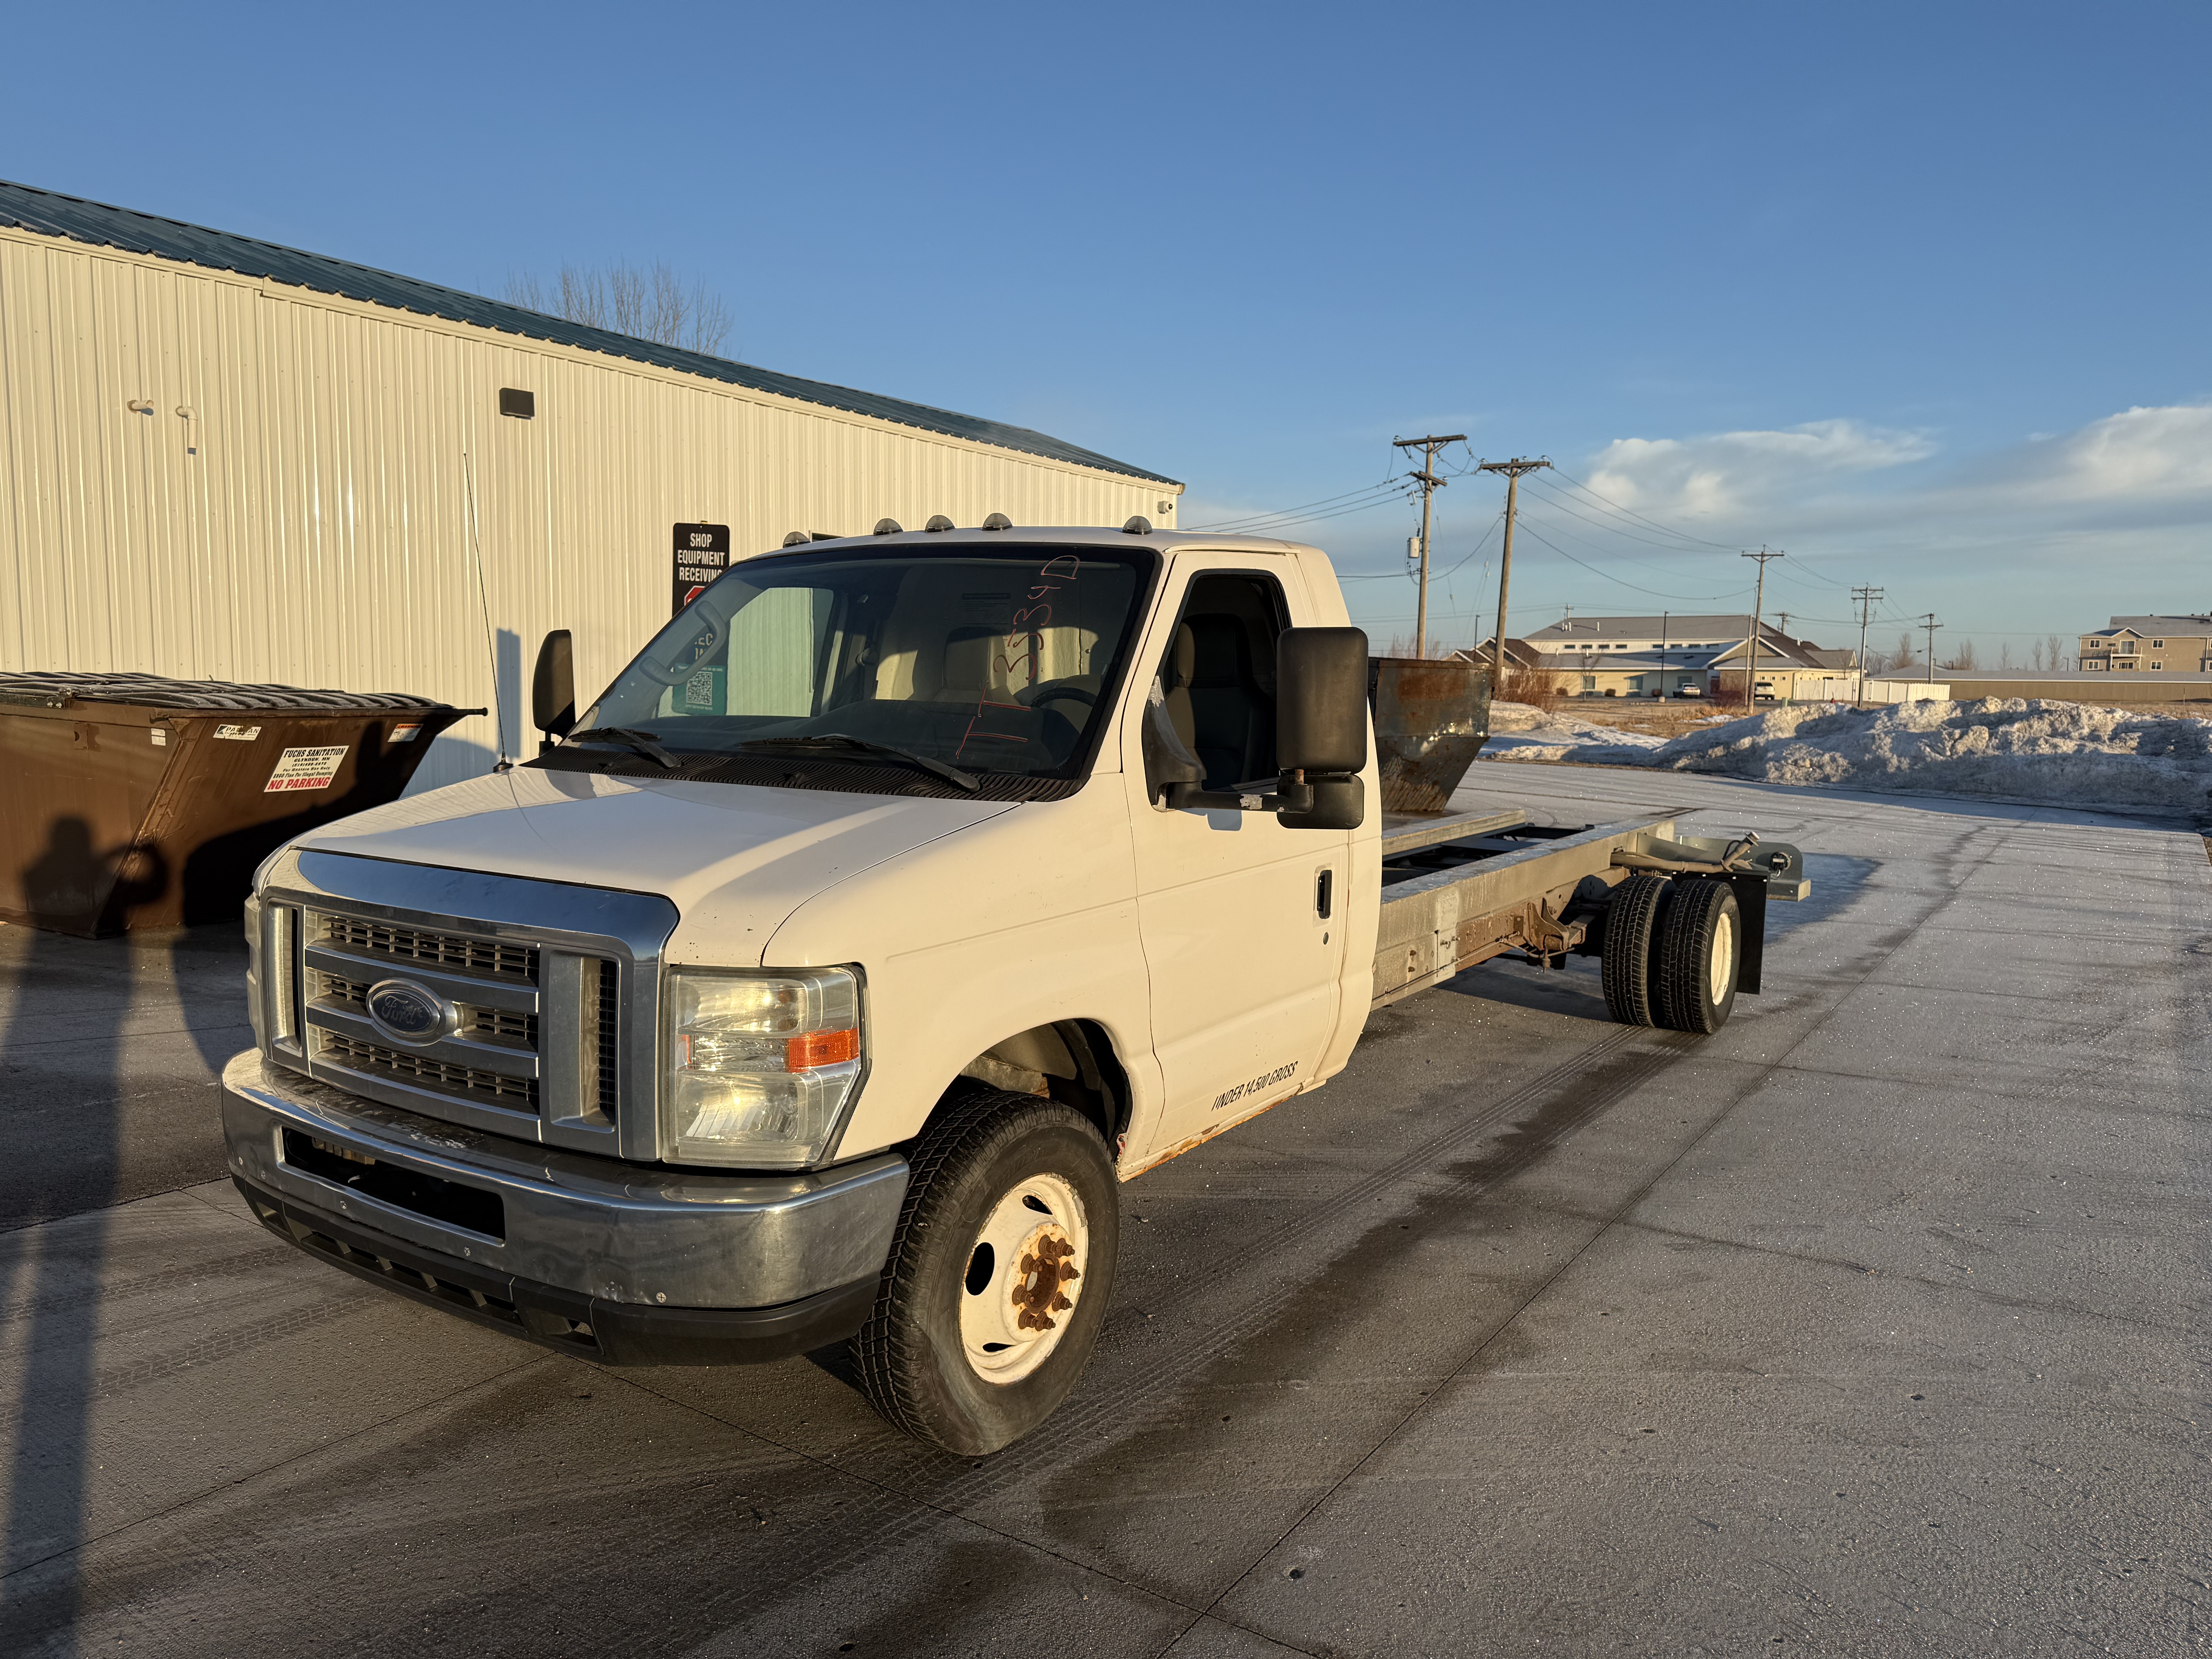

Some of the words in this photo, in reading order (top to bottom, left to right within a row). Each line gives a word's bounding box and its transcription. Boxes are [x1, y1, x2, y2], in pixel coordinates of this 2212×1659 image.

[690, 533, 712, 548] SHOP
[678, 550, 725, 566] EQUIPMENT
[283, 750, 306, 758] FUCHS
[307, 748, 345, 756] SANITATION
[267, 780, 284, 790] NO
[284, 777, 331, 789] PARKING
[381, 995, 417, 1025] Ford
[1211, 1083, 1245, 1112] UNDER
[1243, 1072, 1271, 1097] 14,500
[1268, 1061, 1298, 1086] GROSS
